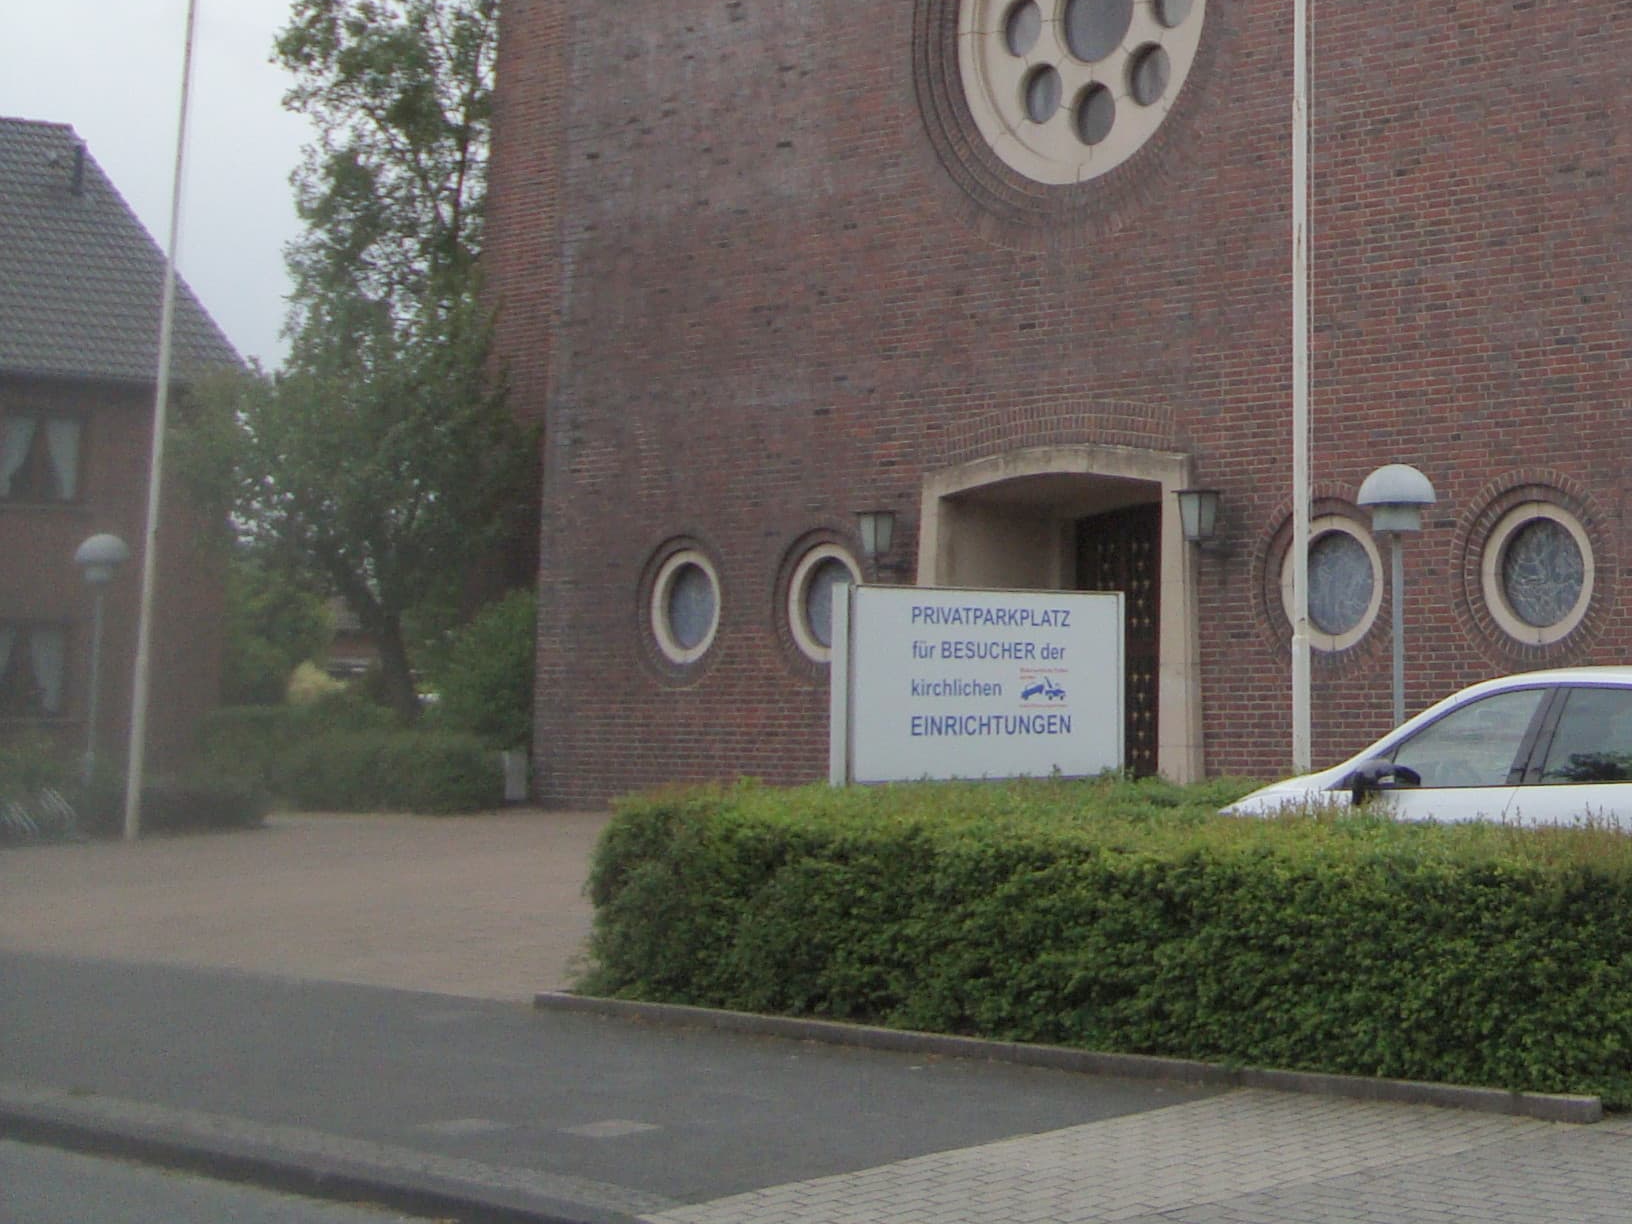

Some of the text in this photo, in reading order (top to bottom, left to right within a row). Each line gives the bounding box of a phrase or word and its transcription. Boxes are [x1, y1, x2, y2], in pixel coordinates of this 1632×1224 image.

[911, 606, 1071, 627] PRIVATPARKPLATZ
[912, 640, 1066, 661] für BESUCHER der
[911, 678, 1002, 697] kirchlichen
[911, 715, 1071, 736] EINRICHTUNGEN
